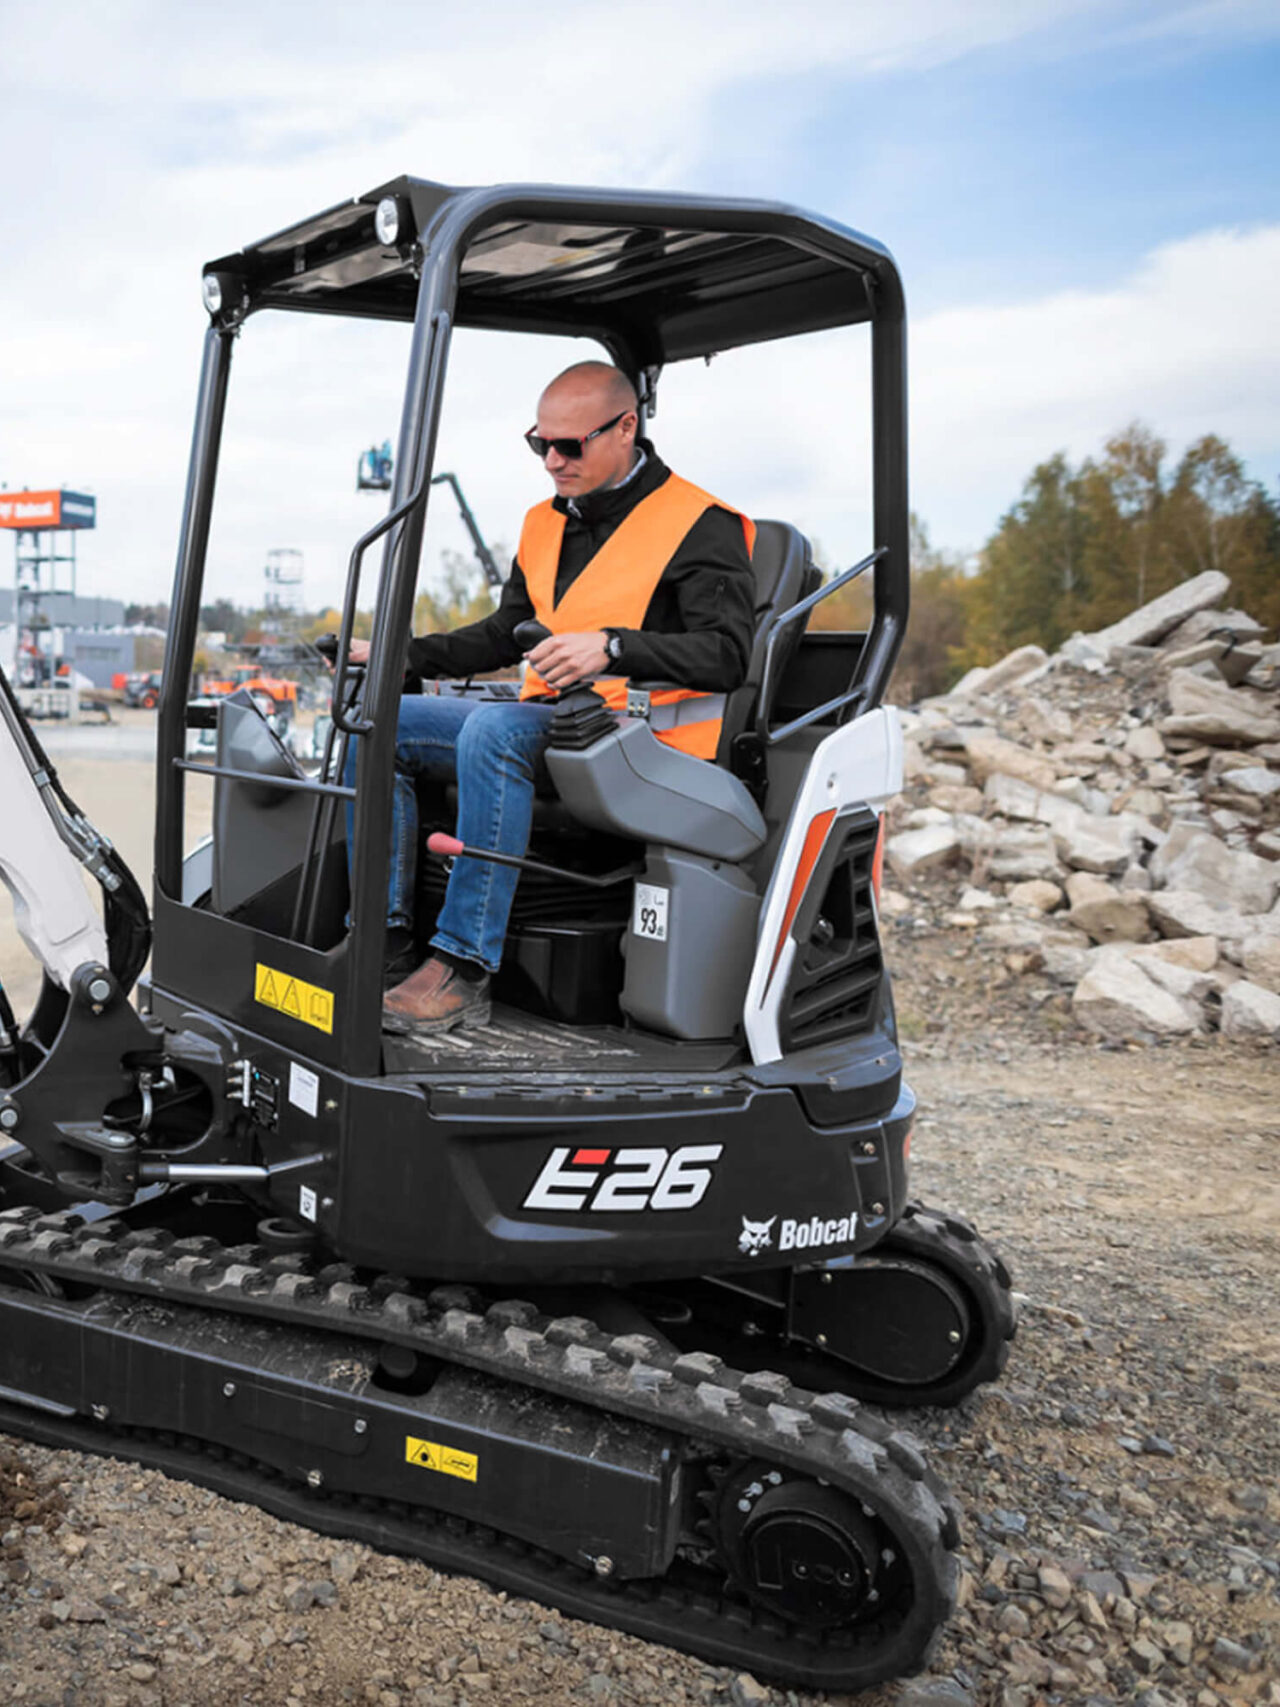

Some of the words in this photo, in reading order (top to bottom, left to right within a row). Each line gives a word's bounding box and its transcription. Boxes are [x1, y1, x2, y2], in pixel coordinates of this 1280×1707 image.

[641, 907, 658, 935] 93
[523, 1144, 723, 1211] E26
[778, 1211, 859, 1252] Bobcat
